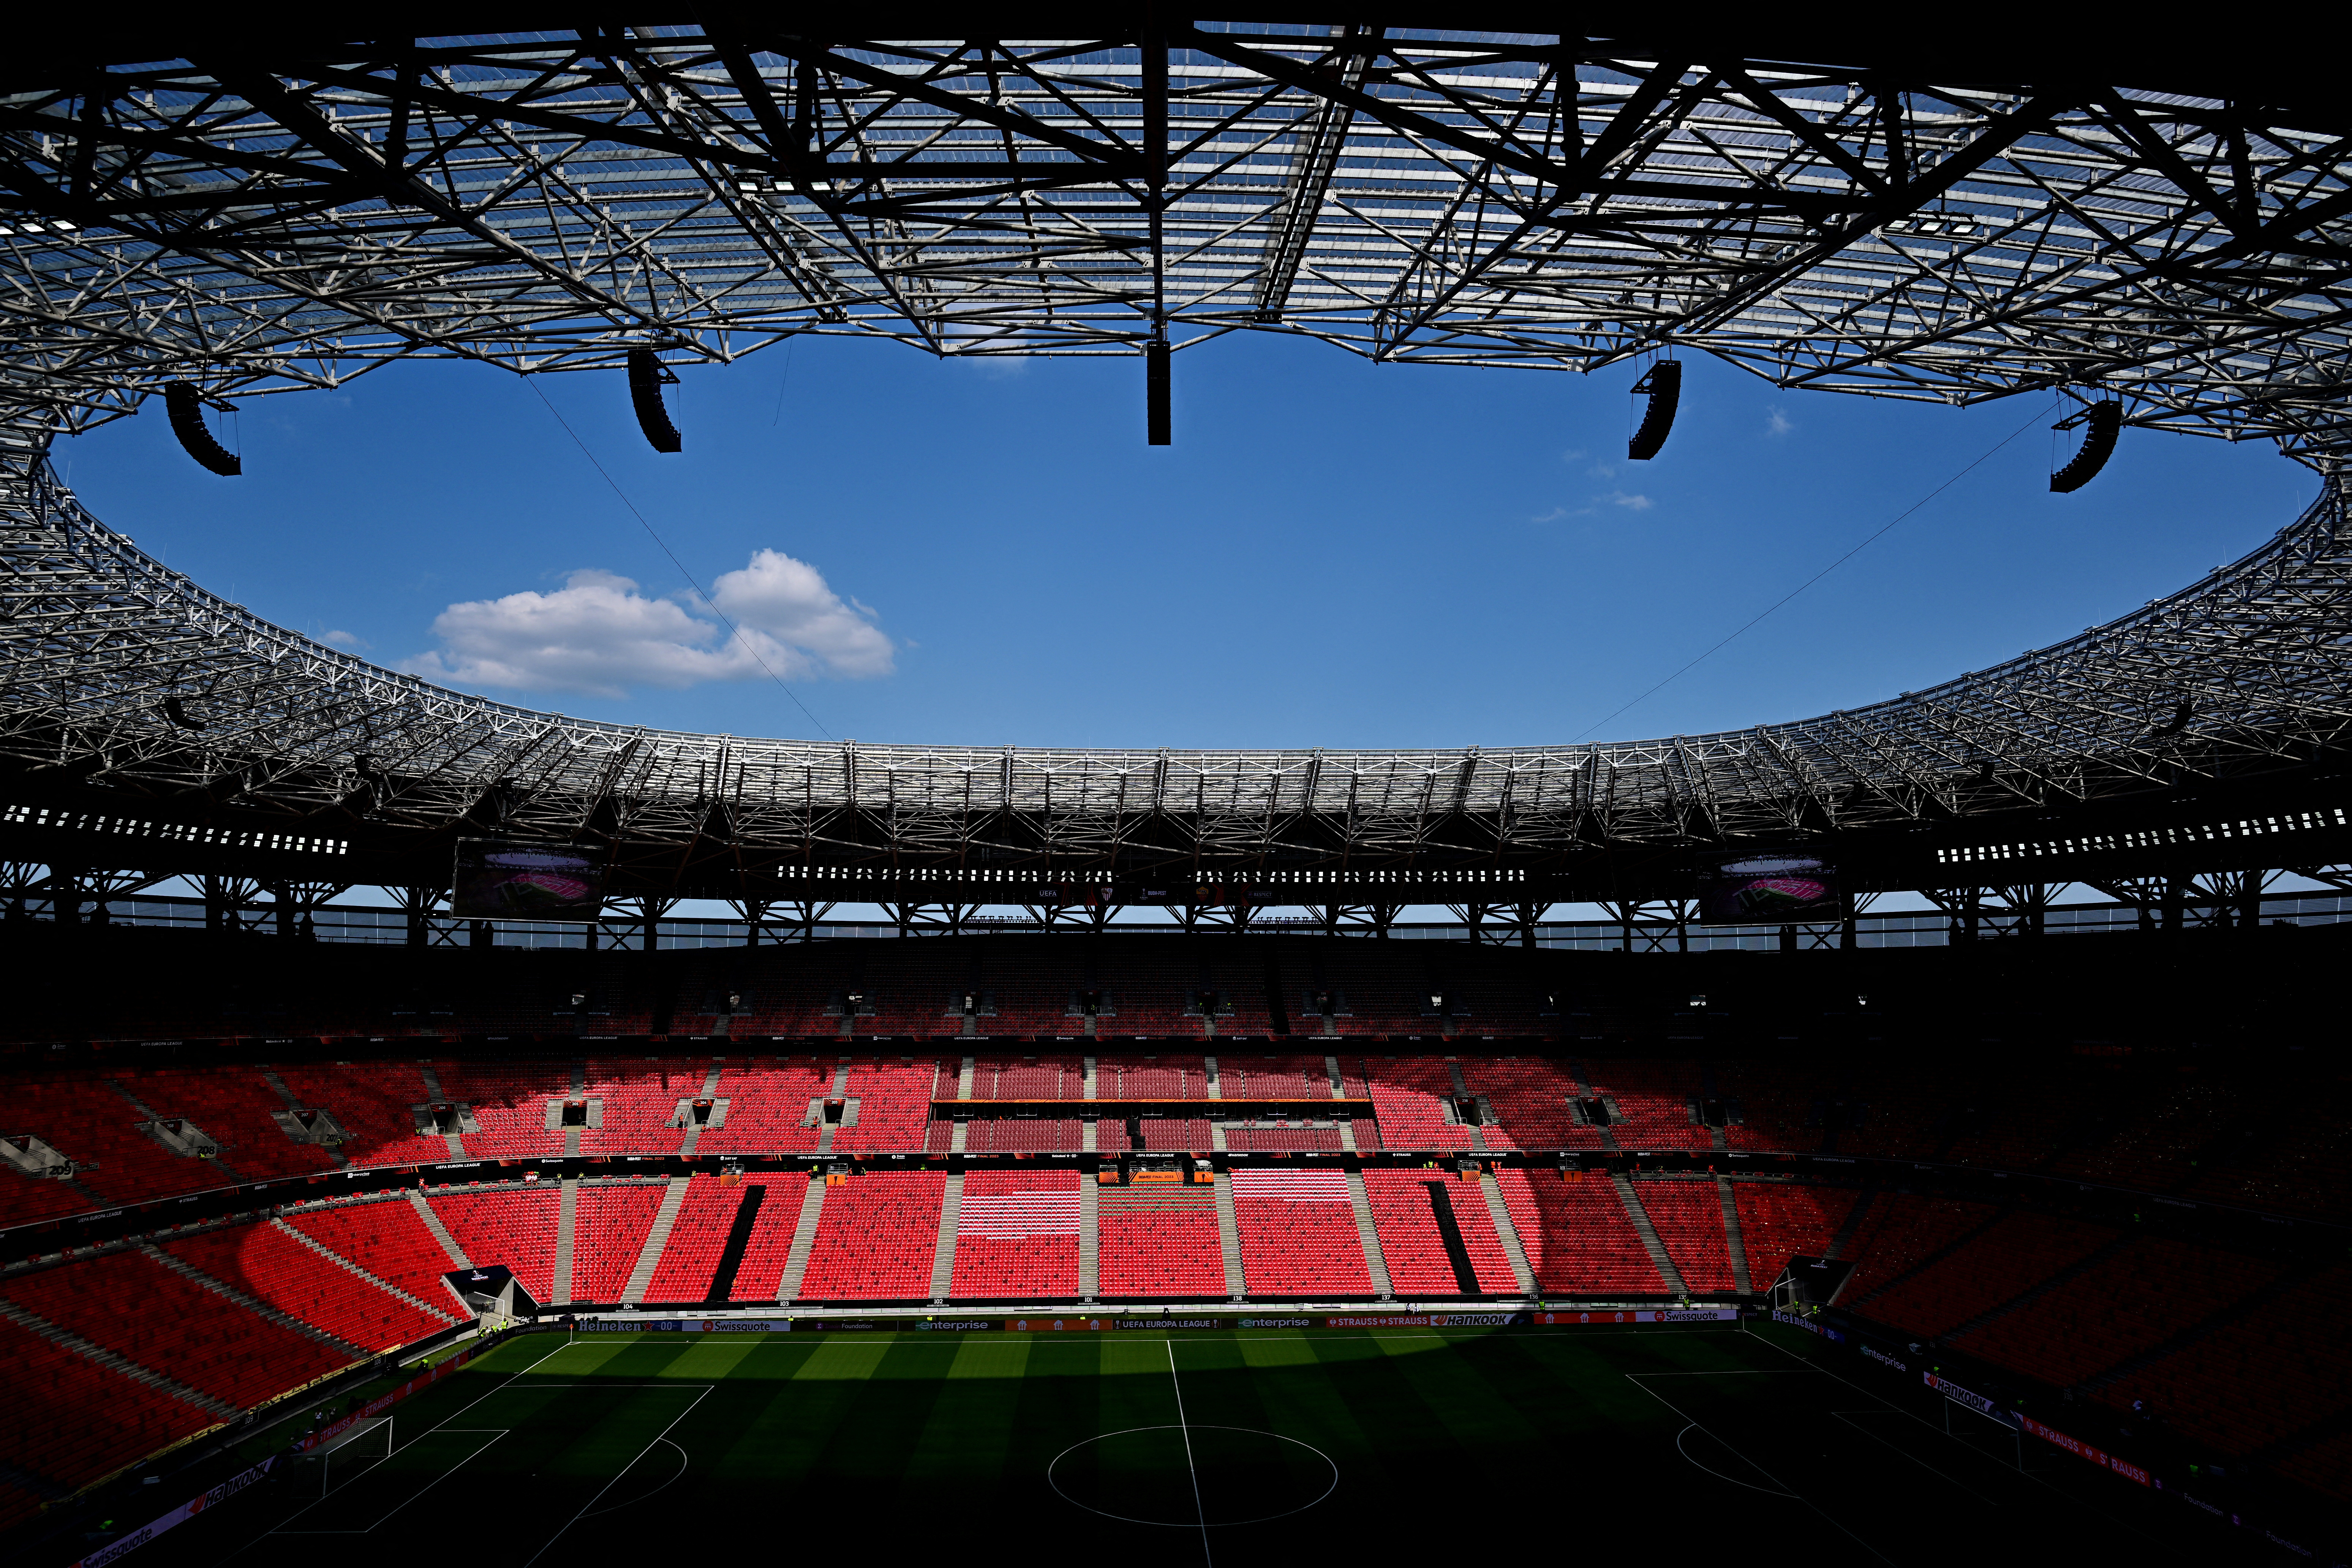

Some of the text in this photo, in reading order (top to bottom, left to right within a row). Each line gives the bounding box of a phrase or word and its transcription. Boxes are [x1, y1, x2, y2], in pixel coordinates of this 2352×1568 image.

[198, 1146, 215, 1155] 208
[49, 1165, 71, 1175] 209
[1667, 1311, 1718, 1320] Swissquote
[579, 1321, 644, 1331] Heineken
[715, 1321, 770, 1331] Swissquote
[916, 1320, 988, 1331] enterprise
[1238, 1318, 1309, 1328] enterprise
[1772, 1310, 1818, 1333] Heineken
[515, 1325, 547, 1334] Foundation
[1861, 1346, 1906, 1371] enterprise
[2064, 1392, 2072, 1400] 130
[365, 1394, 394, 1416] STRAUSS
[2039, 1426, 2145, 1482] STRAUSS SRAUSS
[2184, 1493, 2224, 1517] Foundation
[84, 1528, 152, 1568] Swissquote
